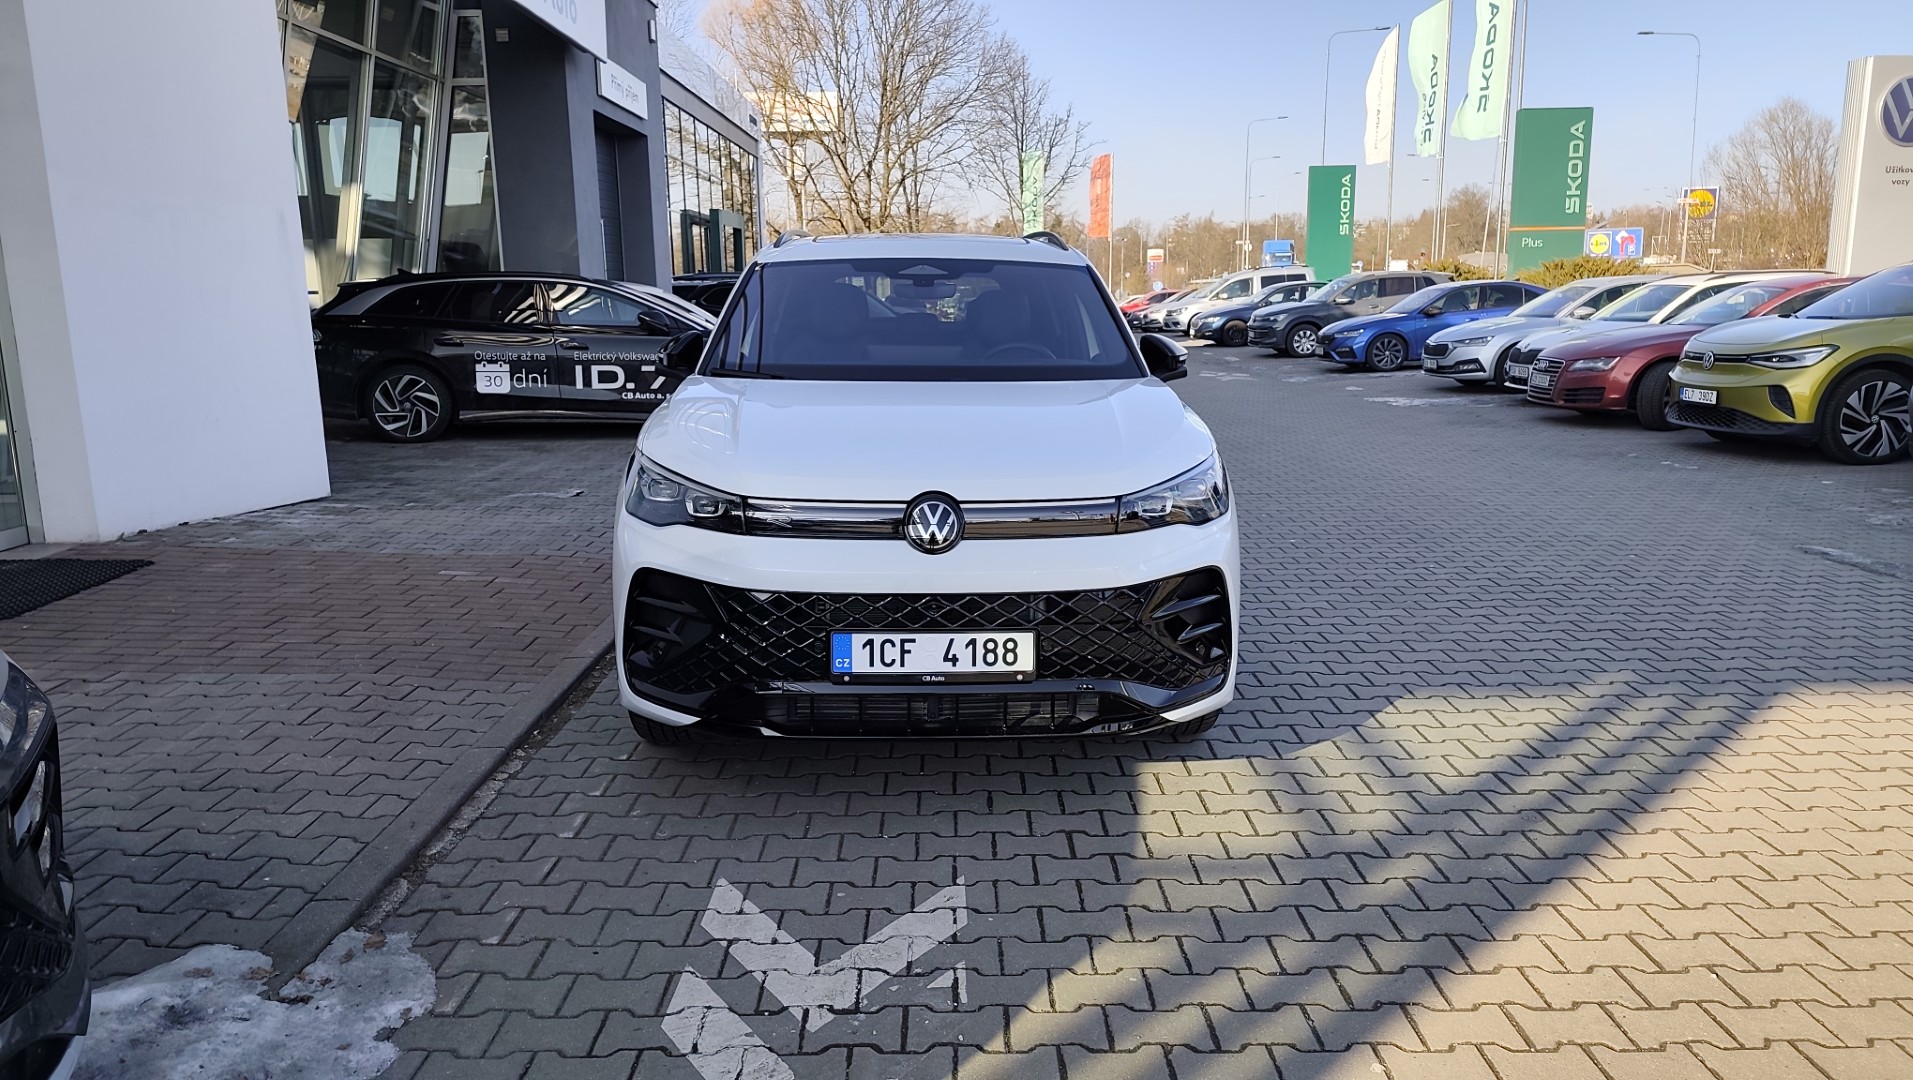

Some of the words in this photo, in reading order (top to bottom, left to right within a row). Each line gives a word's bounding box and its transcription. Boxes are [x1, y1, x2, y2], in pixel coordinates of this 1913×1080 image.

[544, 0, 577, 24] uto
[1891, 179, 1911, 187] vozy
[1521, 237, 1544, 248] Plus
[474, 350, 518, 362] Otestujte
[520, 351, 532, 361] až
[533, 353, 546, 361] na
[573, 351, 617, 363] Elektrický
[484, 375, 503, 387] 30
[513, 368, 547, 388] dní
[621, 392, 634, 400] CB
[635, 392, 656, 400] Auto
[835, 658, 850, 668] CZ
[861, 637, 917, 668] 1CF
[942, 637, 1019, 667] 4188
